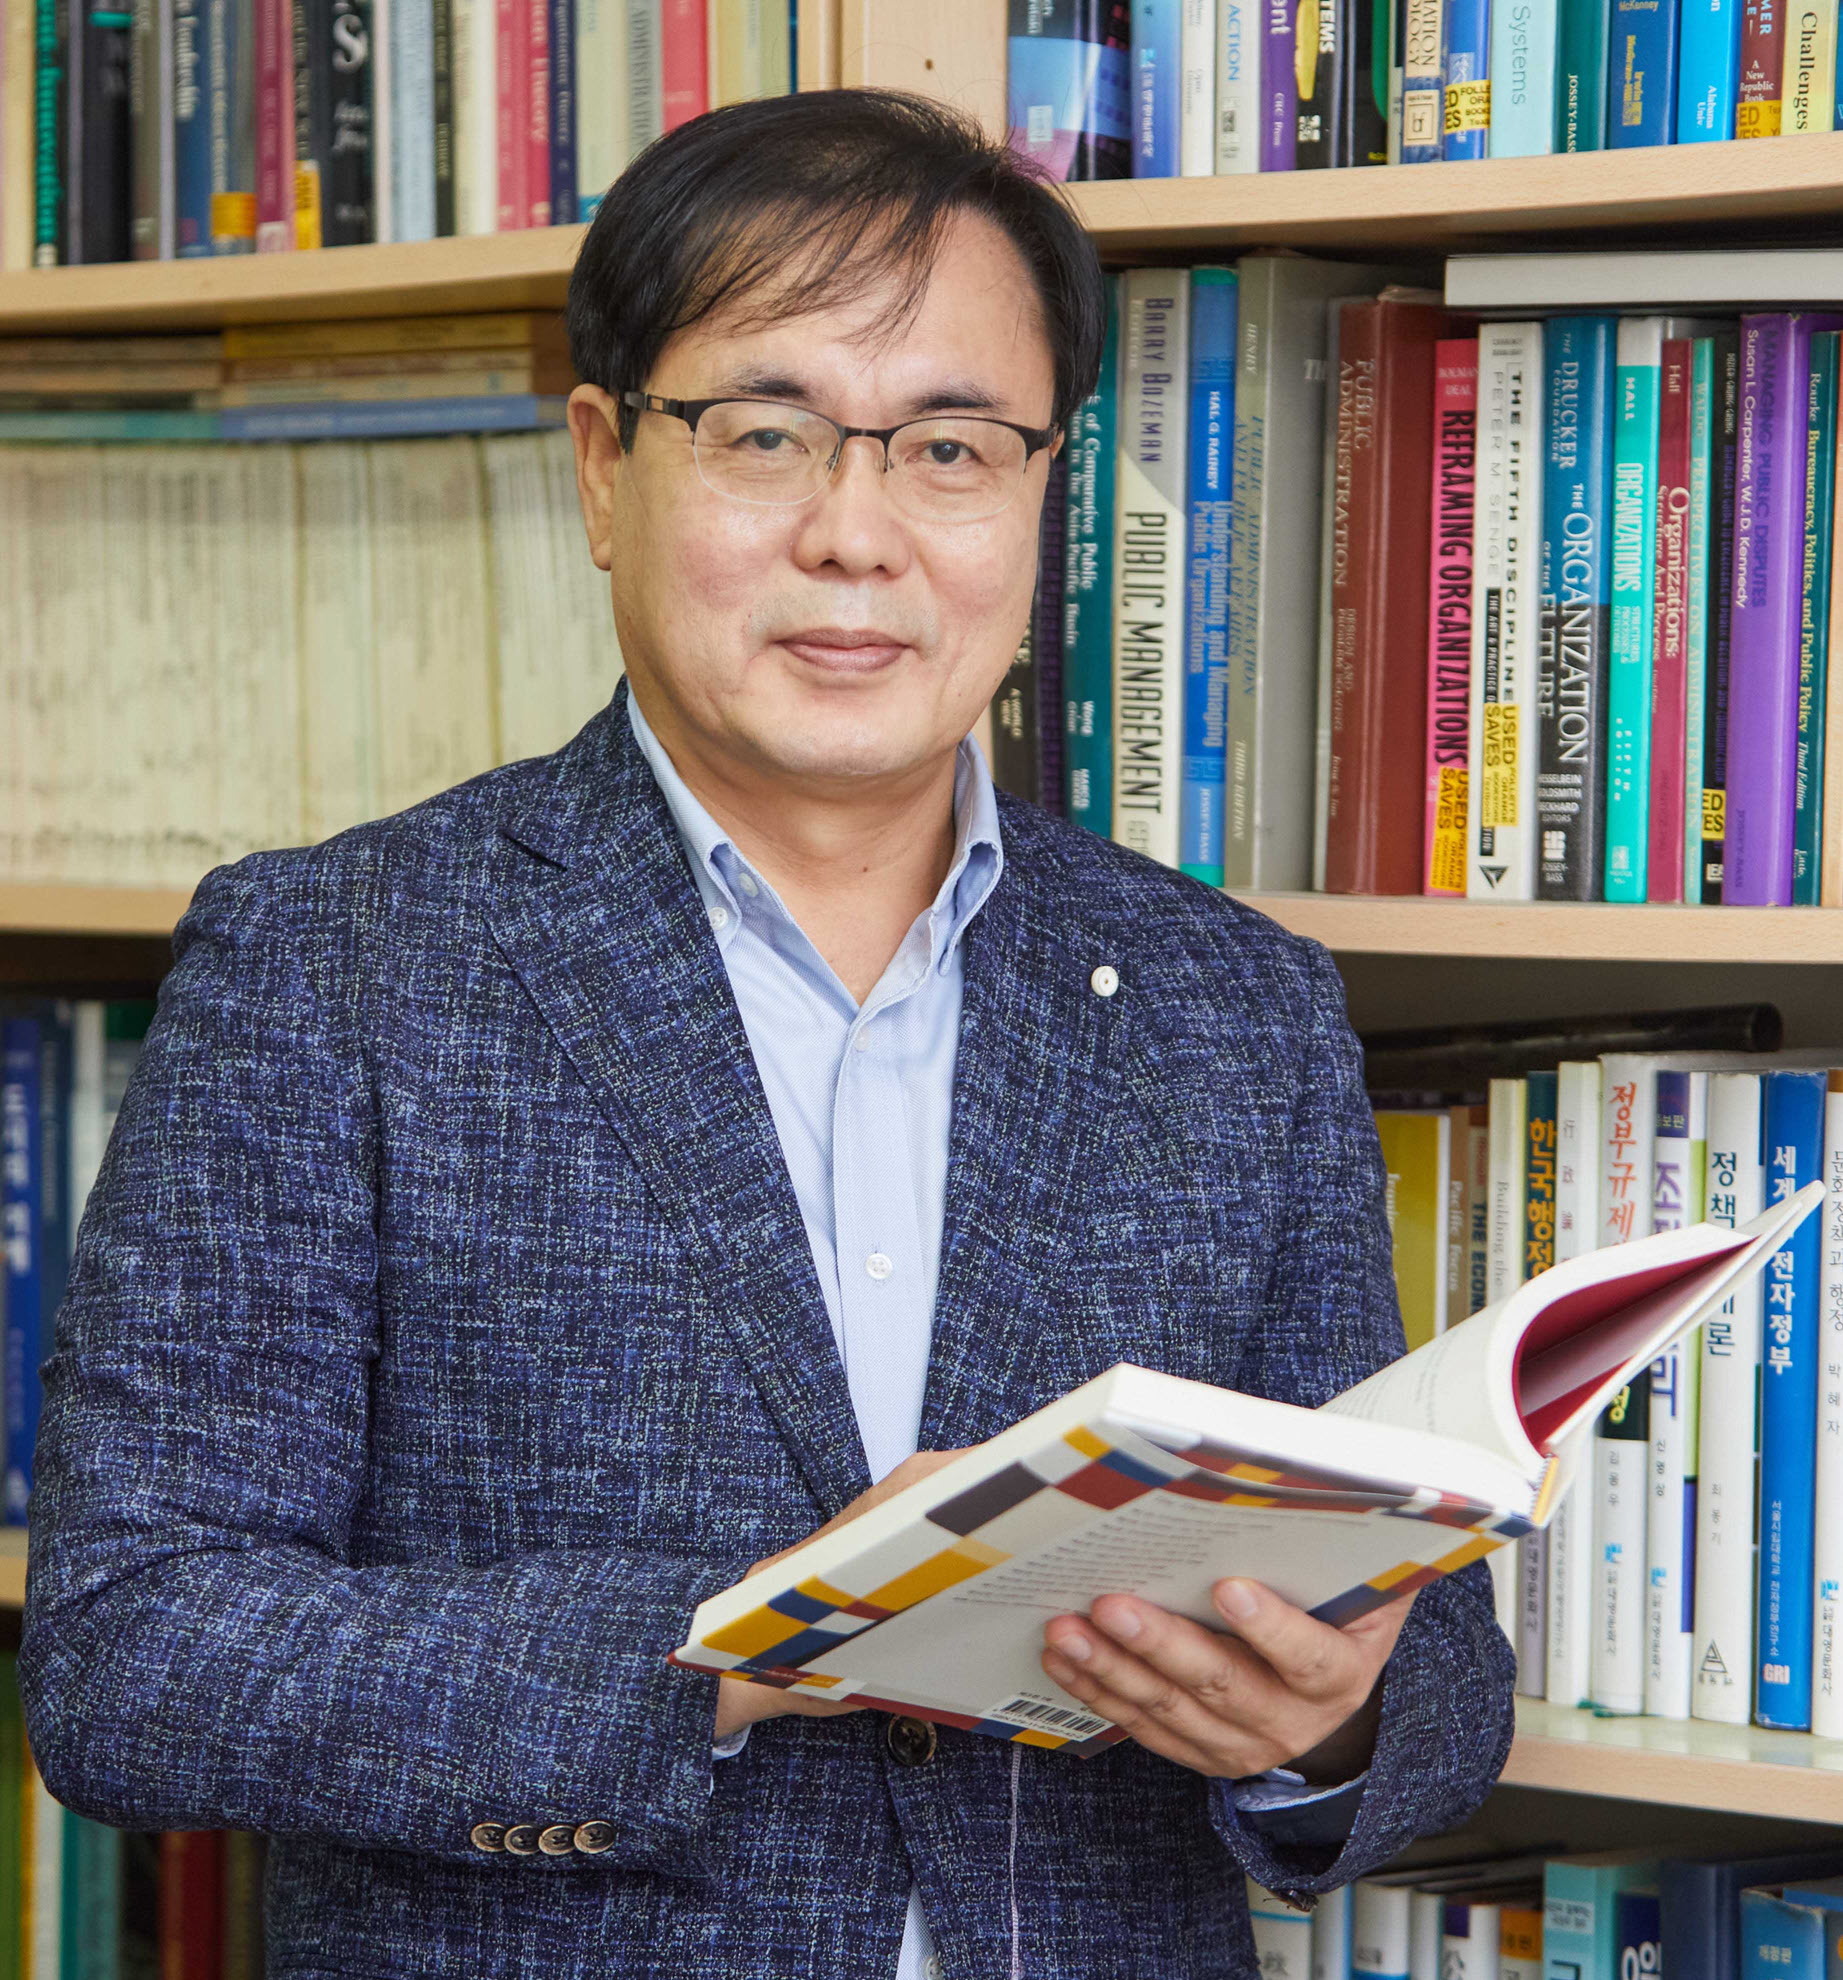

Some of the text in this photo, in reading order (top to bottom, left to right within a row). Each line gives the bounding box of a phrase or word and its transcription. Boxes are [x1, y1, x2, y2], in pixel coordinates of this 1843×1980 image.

[1227, 3, 1242, 82] ACTION
[1509, 5, 1531, 106] Systems
[1739, 80, 1775, 94] Republic
[1746, 70, 1765, 81] New
[1752, 59, 1760, 70] A
[1792, 11, 1818, 130] Challenges
[1567, 73, 1579, 153] JOSSEY-BASS
[1696, 101, 1706, 128] Univ.
[1706, 85, 1718, 129] Alabama
[1139, 297, 1176, 463] BARRY BOZEMAN
[1245, 322, 1259, 376] HENRY
[1666, 365, 1682, 394] Hall
[1206, 390, 1223, 491] HAL RAINEY
[1490, 371, 1506, 449] PETER
[1550, 370, 1563, 464] FOUNDATION
[1558, 333, 1581, 471] THE DRUCKER
[1624, 377, 1637, 421] HALL
[1069, 472, 1083, 496] the
[1079, 413, 1101, 591] of Comparative Public
[1333, 358, 1377, 587] PUBLIC ADMINISTRATION
[1735, 329, 1760, 610] Susan L. Carpenter, W.J.D. Kennedy
[1751, 328, 1779, 609] MANAGING PUBLIC DISPUTES
[1067, 504, 1083, 595] Asia-Pacific
[1122, 510, 1168, 612] PUBLIC
[1486, 493, 1502, 580] SENGE
[1503, 370, 1523, 701] THE FIFTH DISCIPLINE
[1613, 463, 1645, 593] ORGANIZATIONS
[1653, 486, 1668, 662] Structure And Process
[1664, 487, 1691, 660] Organizations:
[1187, 501, 1214, 674] Public Organizations
[1202, 501, 1235, 748] Understanding and Managing
[1242, 509, 1263, 697] ADMINISTRATION
[1433, 410, 1478, 768] REFRAMING ORGANIZATIONS
[1486, 613, 1498, 634] ART
[1487, 594, 1499, 609] THE
[1536, 541, 1559, 720] OF THE FUTURE
[1555, 483, 1595, 766] THE ORGANIZATION
[1685, 382, 1707, 832] WALDO PERSPECTIVES ON ADMINISTRATION
[1796, 373, 1823, 811] Rourke Bureaucracy, Politics, and Public Policy Third Edition
[1001, 699, 1011, 727] VIEW
[1118, 619, 1166, 816] MANAGEMENT
[1486, 646, 1497, 693] PRACTICE
[1011, 698, 1024, 739] WORLD
[1080, 700, 1095, 737] Wong
[1484, 706, 1502, 768] SAVES
[1502, 705, 1518, 766] USED
[1199, 788, 1212, 863] JOSSEY-BASS
[1232, 739, 1248, 841] THIRD EDITION
[1438, 766, 1456, 829] SAVES
[1452, 768, 1471, 829] USED
[1450, 1180, 1465, 1235] Pacific
[1525, 1115, 1557, 1279] 한국행정
[1606, 1080, 1638, 1240] 정부규제
[1471, 1202, 1488, 1242] THE
[1493, 1180, 1510, 1288] Building the
[1765, 1250, 1798, 1376] 전자정부
